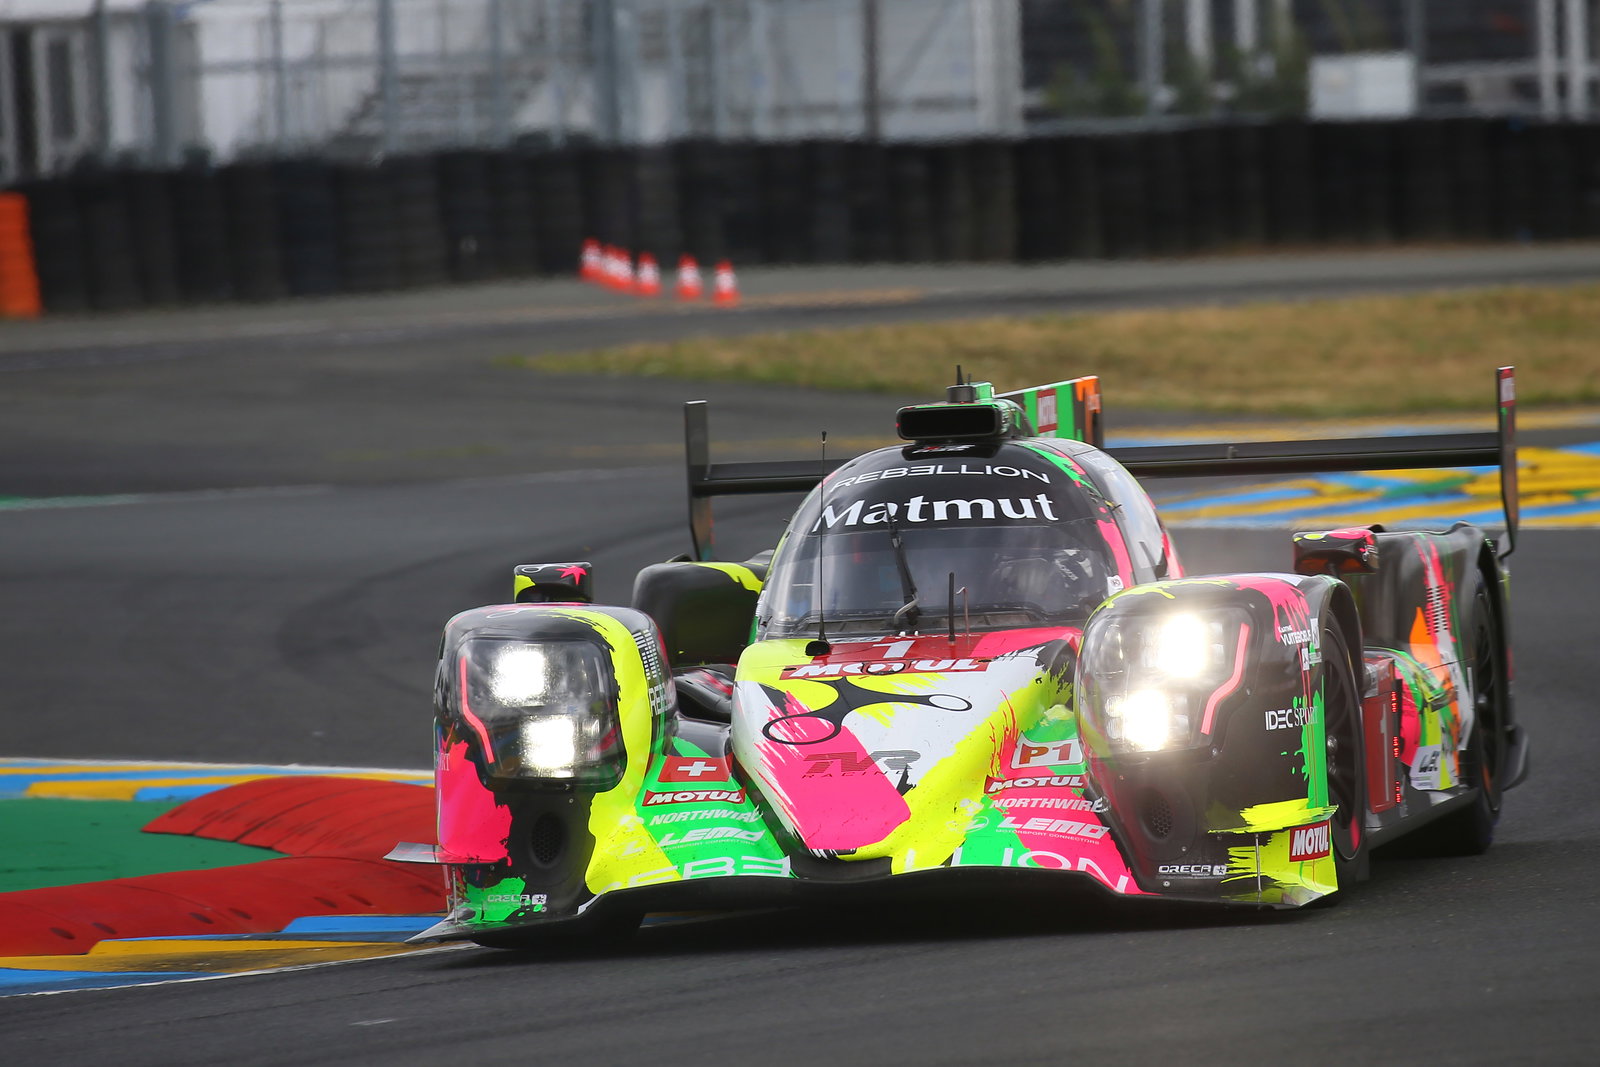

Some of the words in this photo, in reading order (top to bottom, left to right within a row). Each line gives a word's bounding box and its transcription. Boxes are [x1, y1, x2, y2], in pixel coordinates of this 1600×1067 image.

[830, 465, 1051, 492] REBELLION
[812, 494, 1059, 532] Matmut
[873, 640, 916, 659] 1
[789, 659, 981, 678] MOTUL
[1265, 709, 1293, 731] IDEC
[1293, 706, 1319, 727] SPORT
[1019, 743, 1073, 765] P1
[988, 777, 1084, 792] MOTUL
[647, 791, 743, 804] MOTUL
[989, 797, 1108, 813] NORTHWIRE
[657, 827, 766, 847] LEMO
[997, 816, 1110, 839] LEMO
[1048, 833, 1100, 845] CONNECTORS
[1291, 825, 1329, 857] MOTUL
[1158, 864, 1212, 874] ORECA
